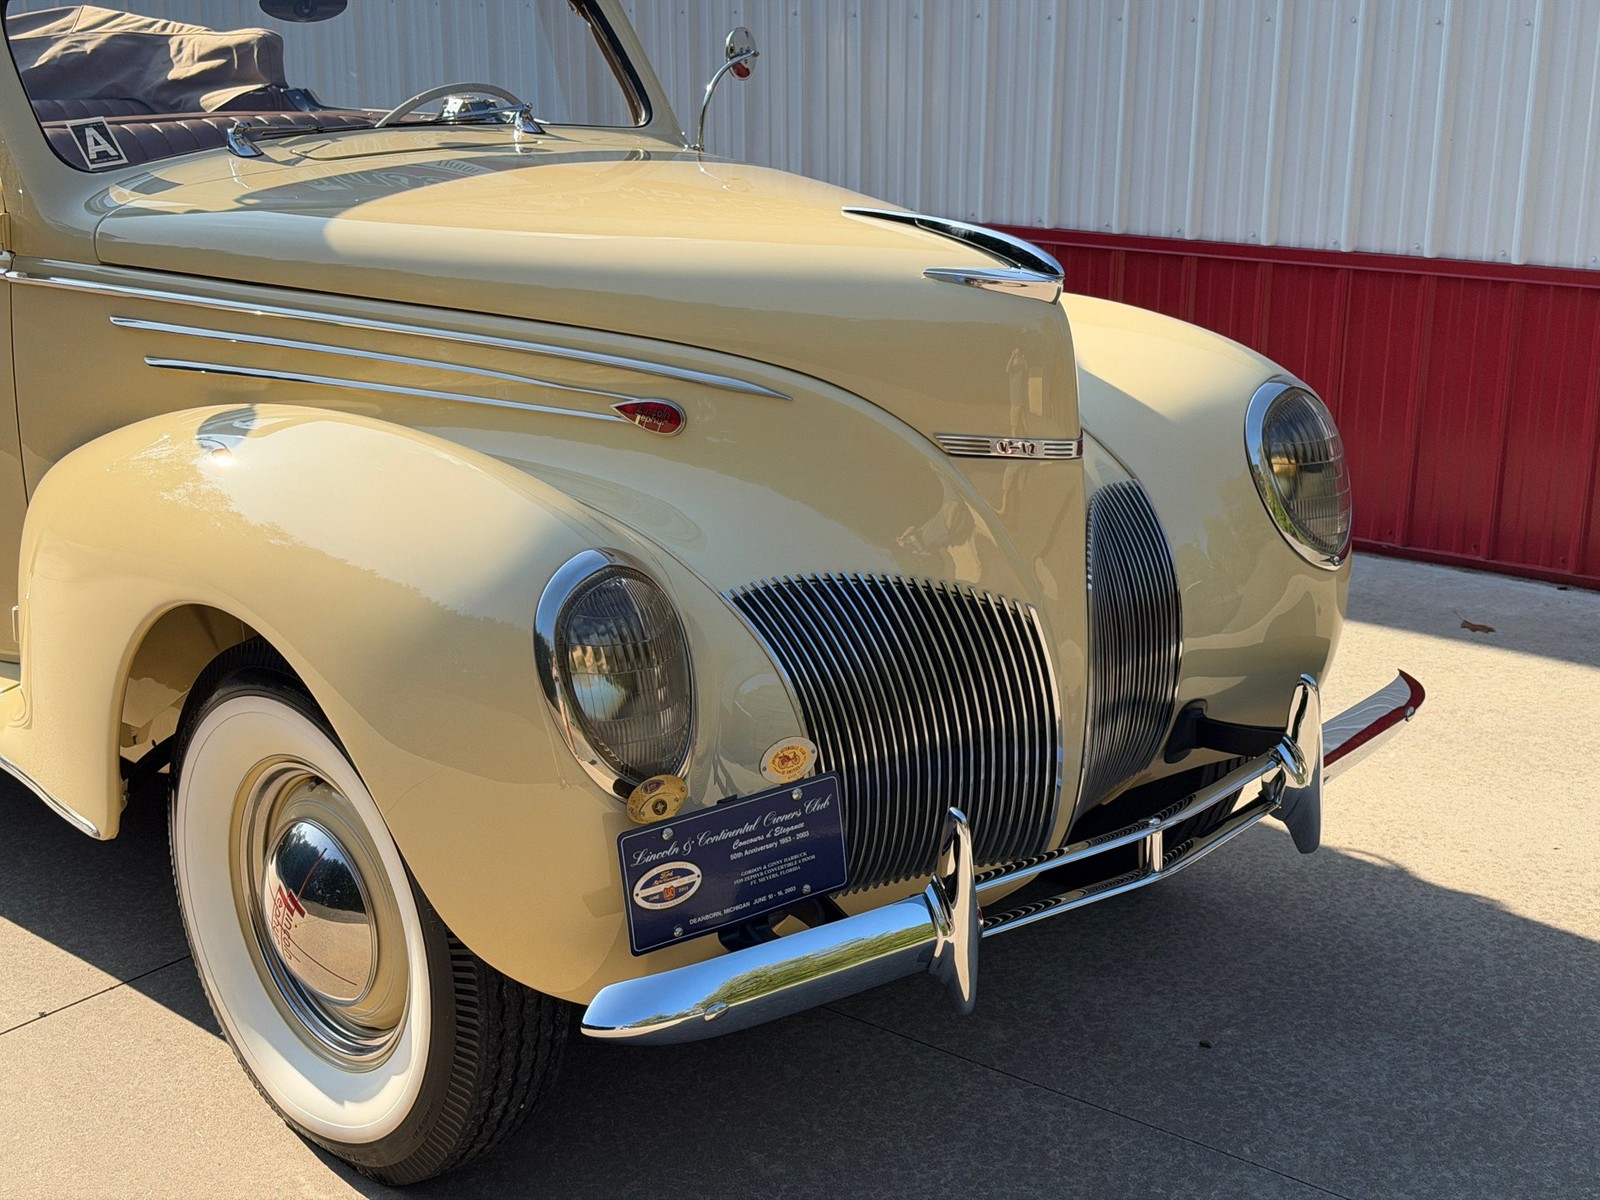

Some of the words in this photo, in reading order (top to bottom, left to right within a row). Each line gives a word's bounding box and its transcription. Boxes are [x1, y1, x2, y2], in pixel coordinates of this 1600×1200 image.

[84, 127, 119, 160] A
[630, 841, 680, 867] Lincoln
[682, 837, 695, 856] &
[697, 815, 762, 847] Continental
[803, 793, 832, 814] Club
[732, 834, 765, 850] Concours
[730, 852, 744, 861] 50th
[744, 840, 778, 857] Anniversary
[779, 836, 792, 845] 1953
[796, 830, 810, 840] 2003
[741, 866, 762, 877] GORDON
[767, 859, 783, 868] GINNY
[744, 871, 764, 882] ZEPHYR
[764, 861, 798, 876] CONVERTIBLE
[801, 854, 816, 864] DOOR
[779, 865, 801, 876] FLORIDA
[689, 910, 723, 925] DEARBORN,
[723, 901, 751, 915] MICHIGAN
[752, 895, 767, 906] JUNE
[784, 885, 797, 895] 2003
